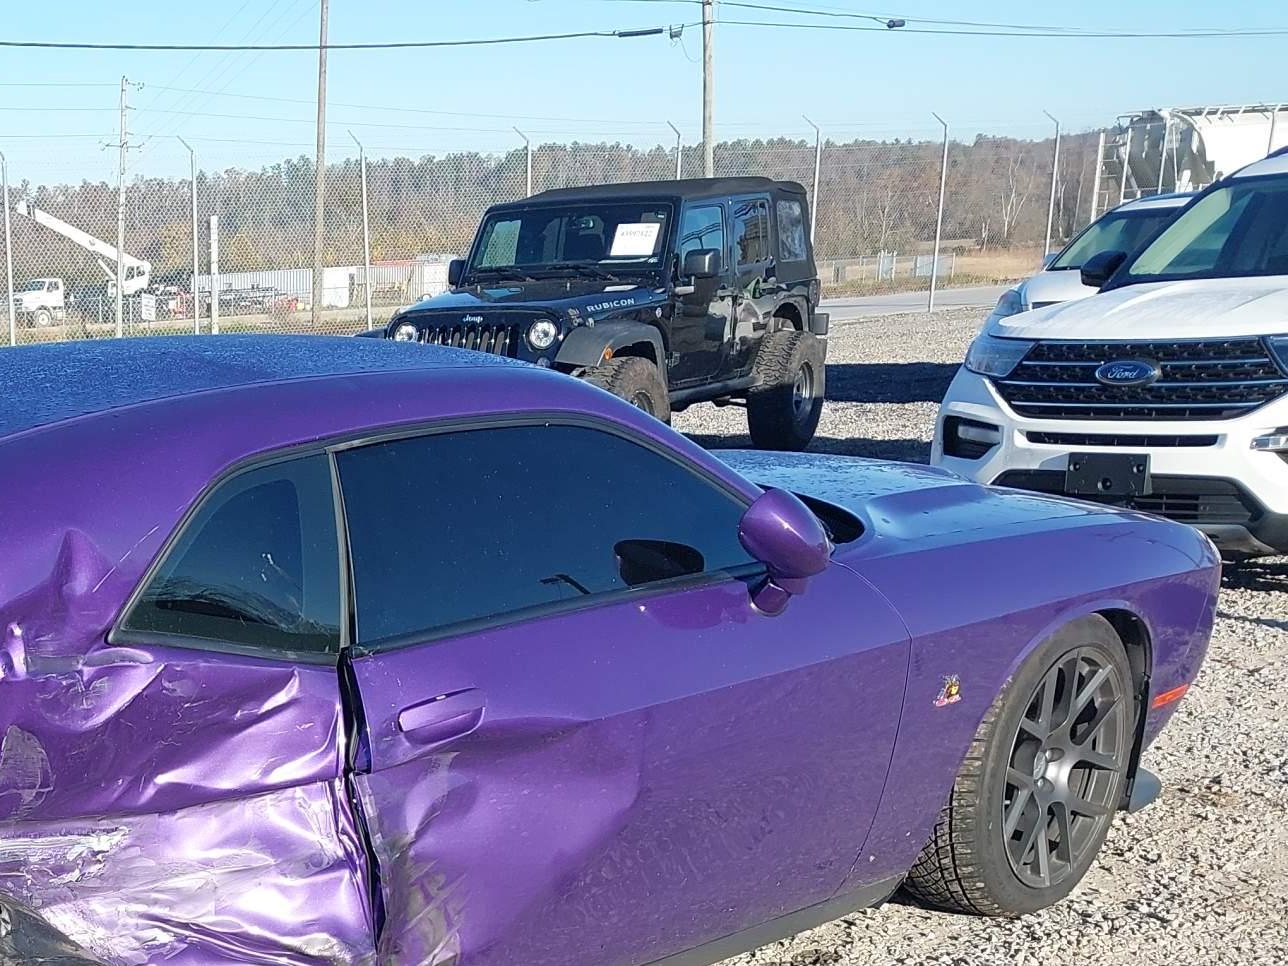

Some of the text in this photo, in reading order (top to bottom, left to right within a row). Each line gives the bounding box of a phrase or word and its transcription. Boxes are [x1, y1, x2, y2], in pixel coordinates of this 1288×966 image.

[586, 298, 635, 312] RUBICON
[462, 313, 484, 324] Jeep
[1107, 367, 1140, 379] Ford
